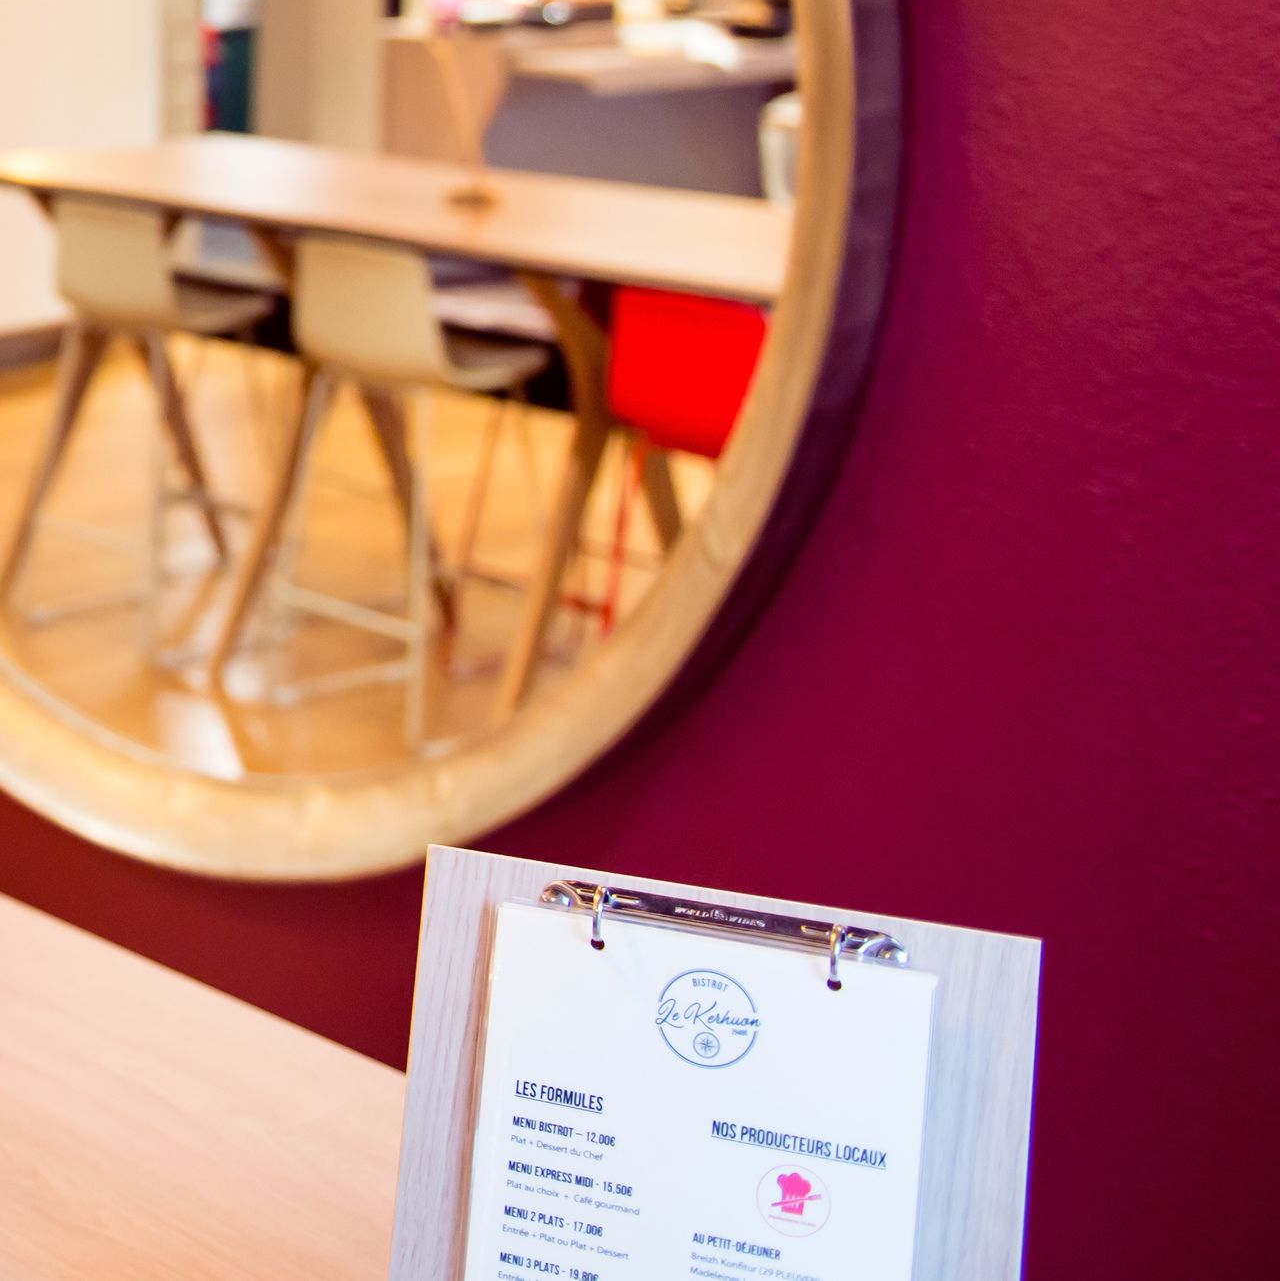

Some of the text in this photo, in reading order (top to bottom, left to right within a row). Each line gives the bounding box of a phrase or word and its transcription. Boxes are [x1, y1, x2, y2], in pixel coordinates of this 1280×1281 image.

[692, 978, 728, 992] BISTROT
[655, 998, 760, 1031] Le Kerhuon
[515, 1080, 604, 1112] LES FORMULES
[511, 1134, 526, 1145] Plat
[536, 1140, 568, 1154] Dessert
[570, 1148, 581, 1158] du
[583, 1150, 604, 1161] Chef
[512, 1116, 537, 1130] MENU
[539, 1121, 574, 1138] BISTROT
[586, 1131, 616, 1147] 12.00€
[712, 1120, 887, 1168] NOS PRODUCTEURS LOCAUX
[508, 1160, 533, 1175] MENU
[534, 1166, 572, 1184] EXPRESS
[575, 1174, 594, 1188] MIDI
[603, 1181, 633, 1197] 15.50€
[506, 1179, 522, 1190] Plat
[524, 1184, 534, 1192] au
[536, 1185, 559, 1198] choix
[573, 1194, 593, 1205] Café
[594, 1200, 640, 1216] gourmand
[504, 1205, 528, 1220] MENU
[530, 1211, 536, 1222] 2
[538, 1212, 564, 1229] PLATS
[573, 1221, 603, 1237] 17.00€
[502, 1224, 529, 1238] Entrée
[539, 1232, 555, 1243] Plat
[557, 1238, 569, 1246] ou
[570, 1239, 586, 1251] Plat
[596, 1246, 629, 1260] Dessert
[691, 1252, 719, 1264] Breizh
[692, 1232, 781, 1260] AU PETIT-DÉJEUNER
[499, 1252, 524, 1267] MENU
[526, 1257, 531, 1269] 3
[533, 1260, 560, 1275] PLATS
